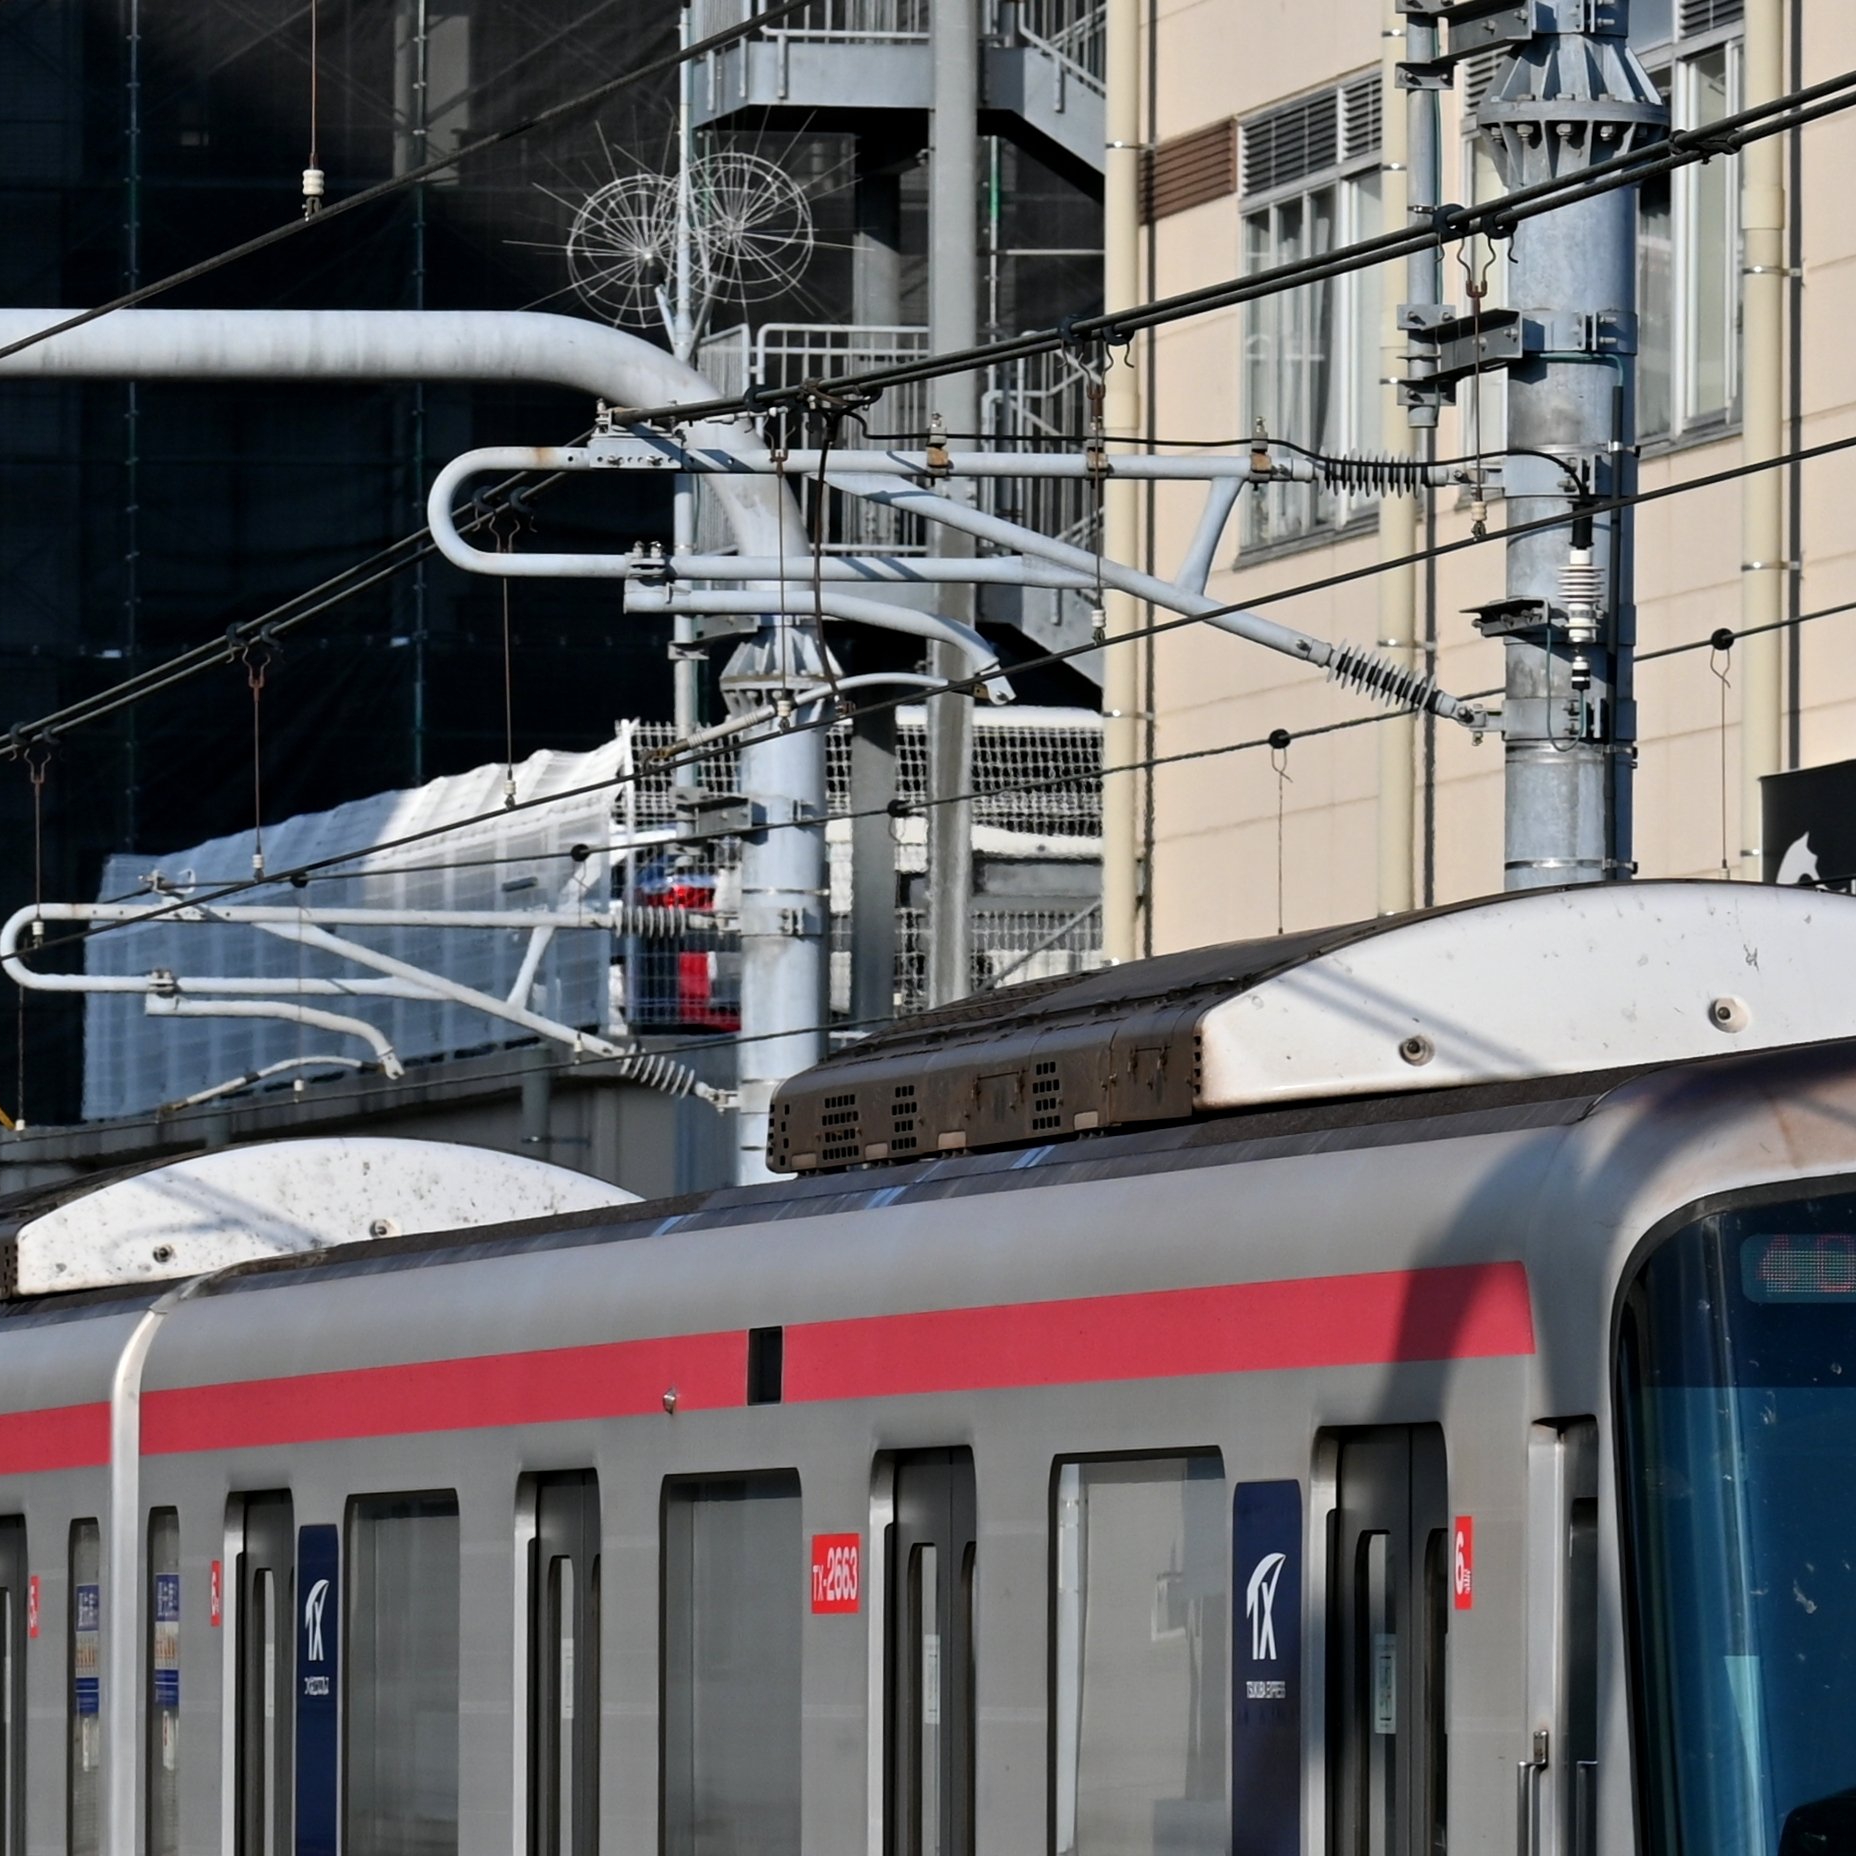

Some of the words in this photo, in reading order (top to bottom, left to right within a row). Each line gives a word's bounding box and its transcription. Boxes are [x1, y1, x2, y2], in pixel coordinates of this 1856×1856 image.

[813, 1546, 857, 1601] TX-2663
[1247, 1552, 1287, 1660] TX
[305, 1579, 330, 1661] TX
